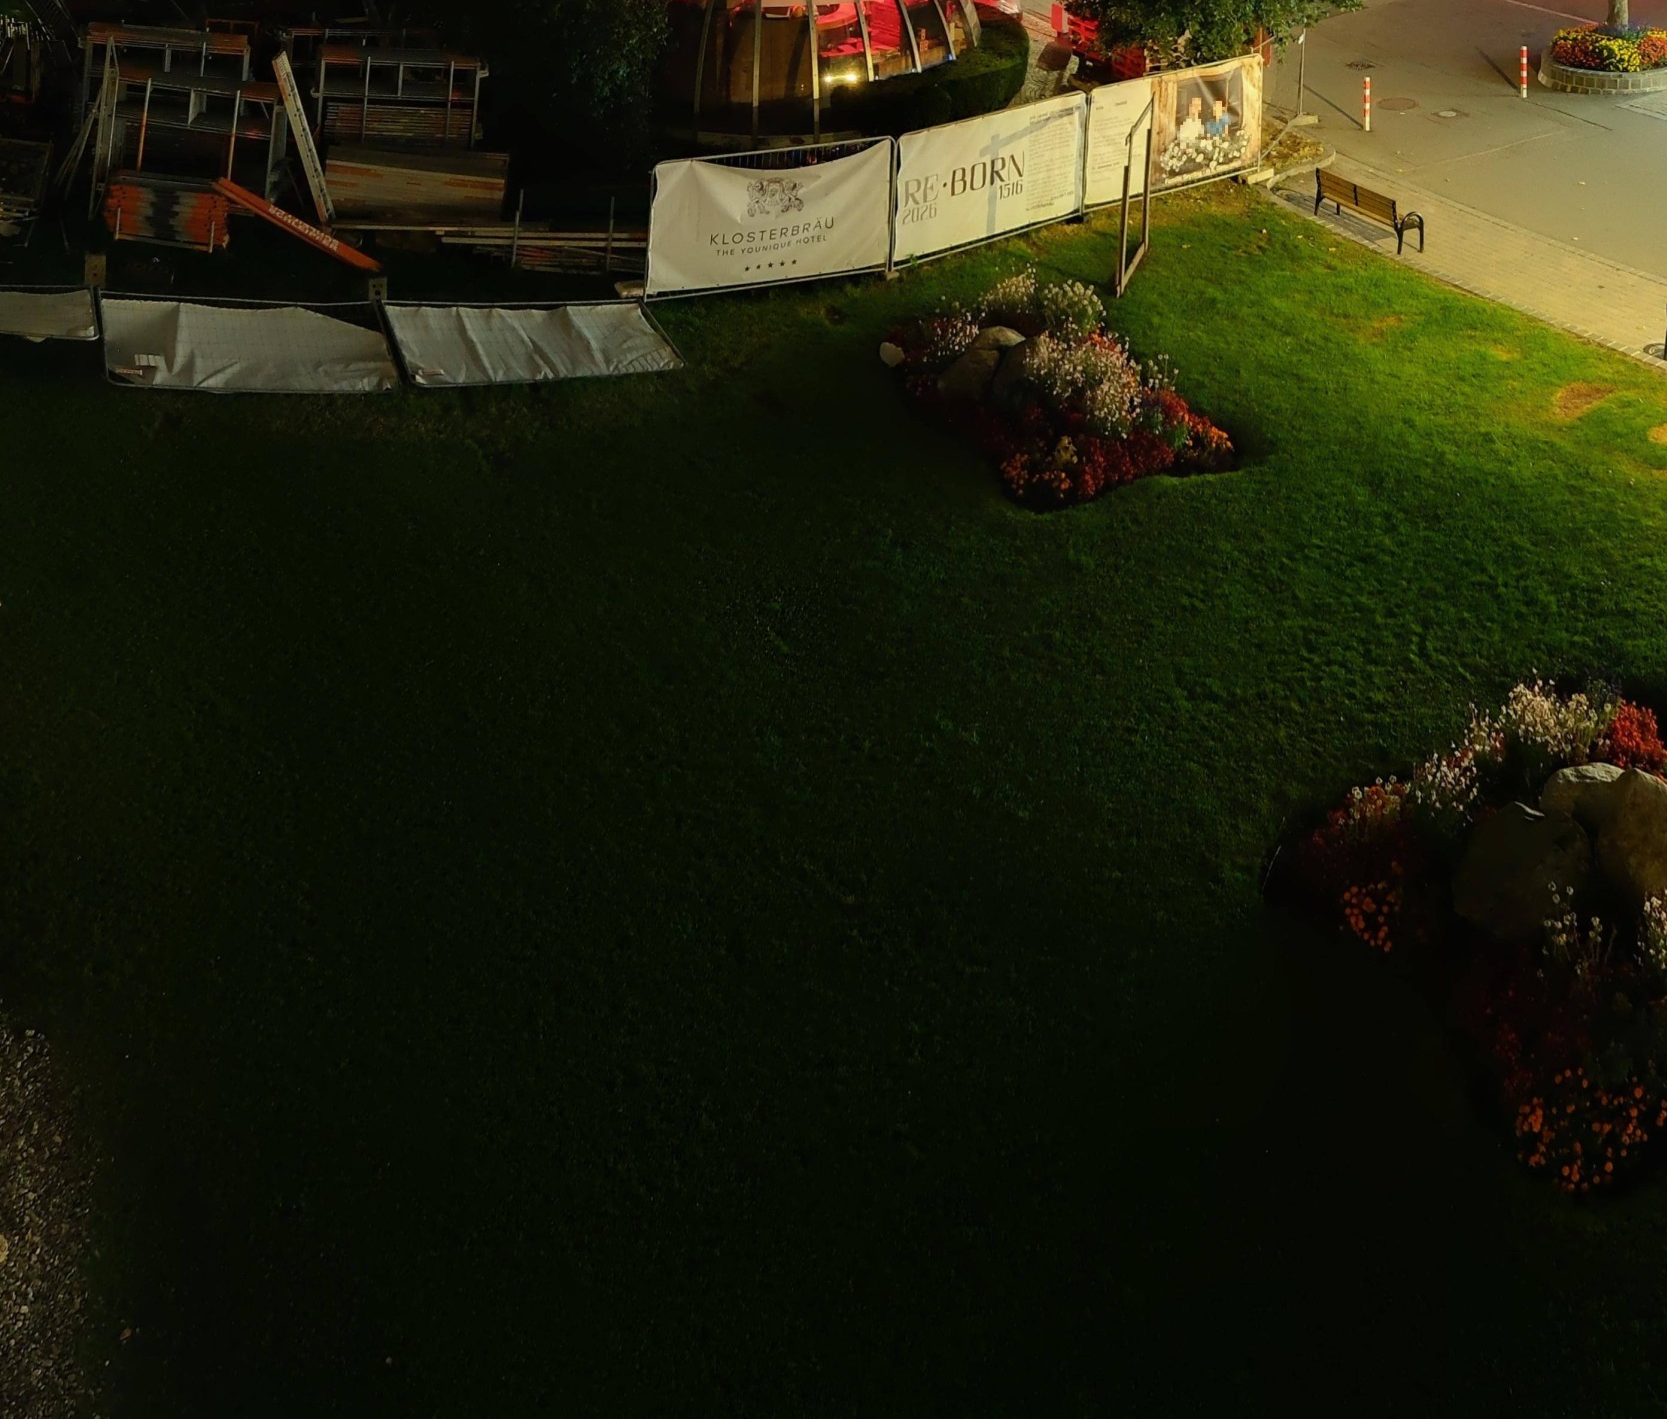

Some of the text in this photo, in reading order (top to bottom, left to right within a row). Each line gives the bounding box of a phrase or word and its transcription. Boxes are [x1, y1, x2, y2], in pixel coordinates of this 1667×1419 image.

[998, 181, 1023, 200] 1516
[902, 203, 937, 225] 2026
[710, 217, 834, 246] KLOSTERBRÄU
[741, 241, 792, 254] YOUNIQUE
[796, 235, 827, 245] HOTEL
